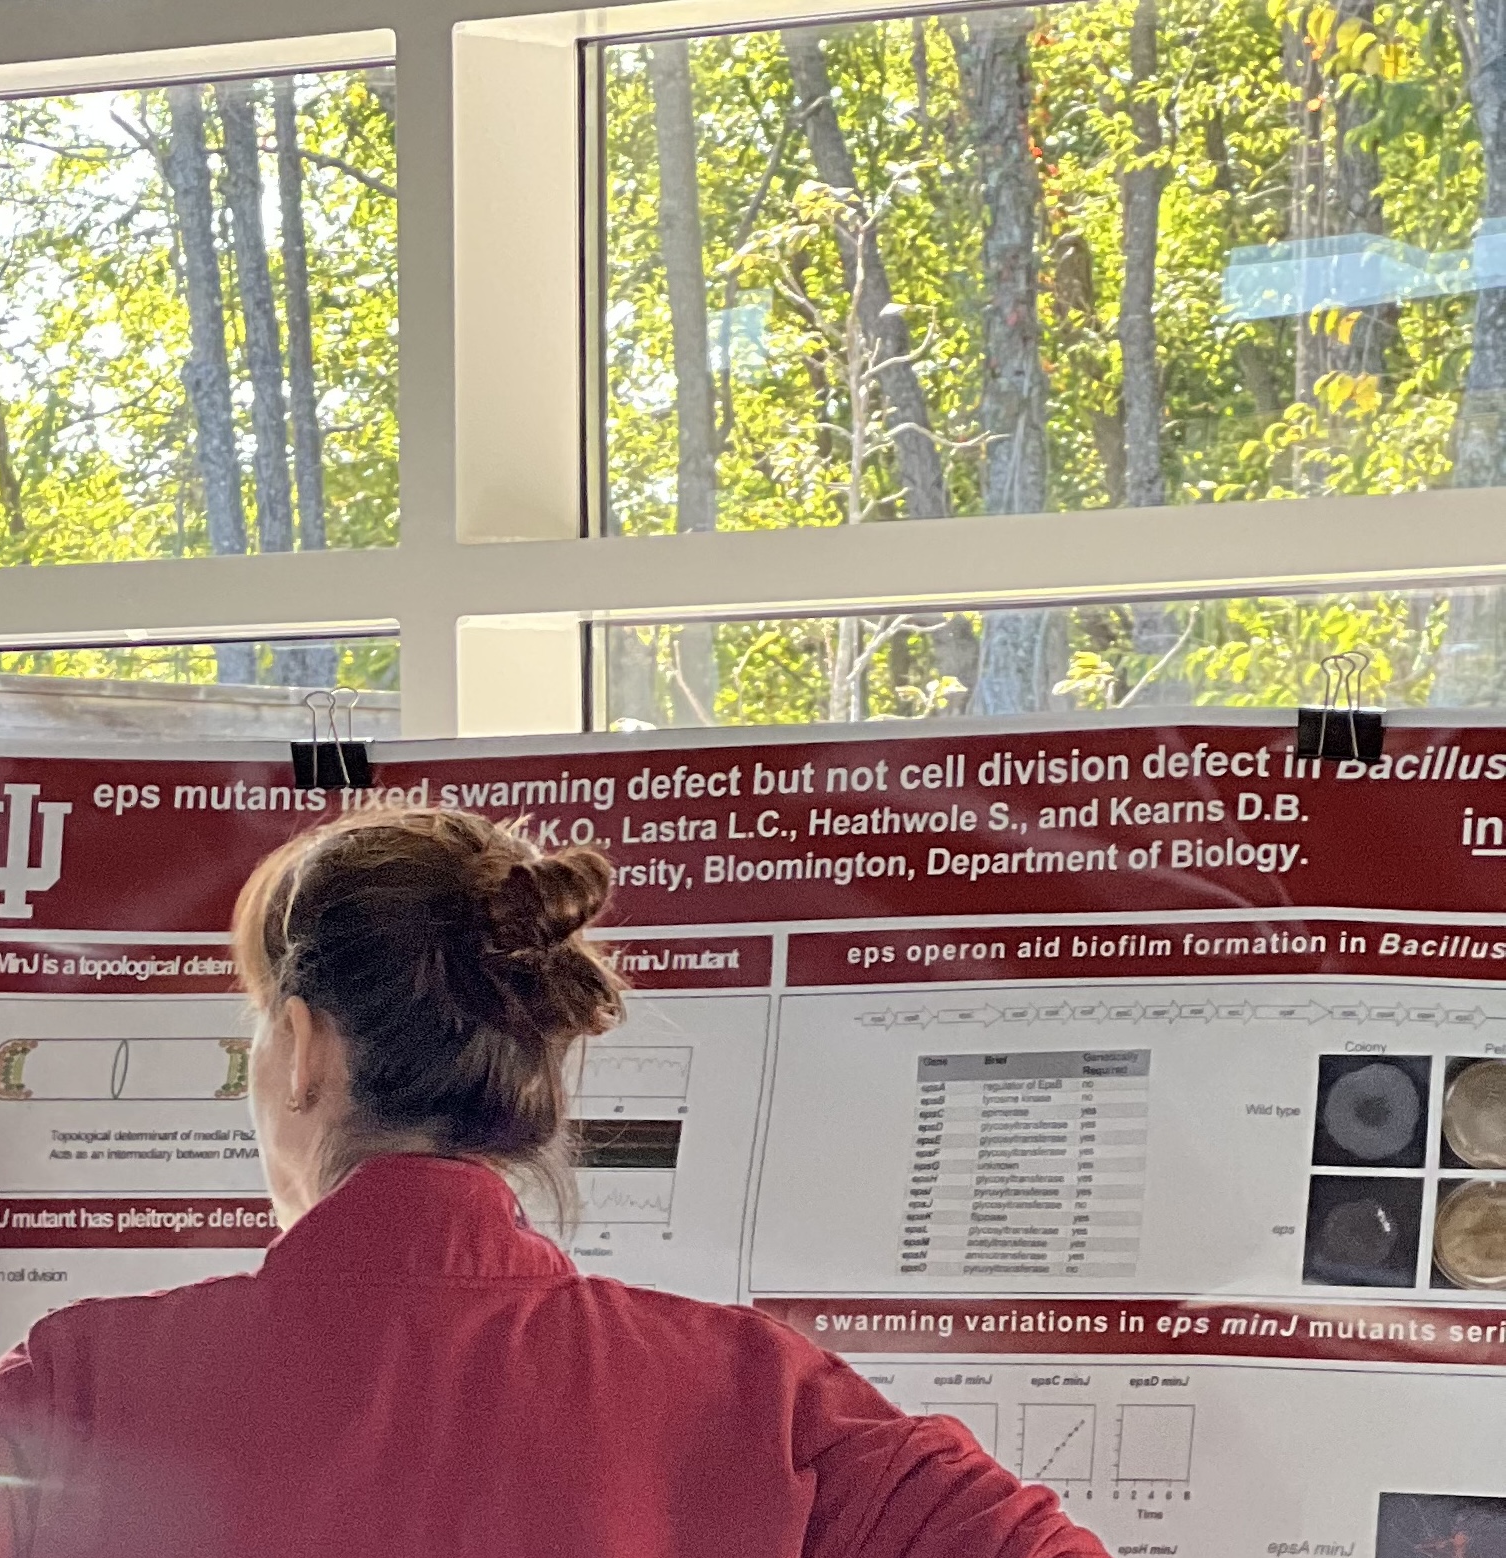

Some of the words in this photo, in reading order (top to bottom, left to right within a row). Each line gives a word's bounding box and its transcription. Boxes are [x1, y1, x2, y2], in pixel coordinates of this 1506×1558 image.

[93, 783, 160, 815] eps
[174, 778, 326, 811] mutants
[340, 777, 428, 811] fixed
[441, 770, 615, 810] swarming
[627, 764, 742, 801] defect
[753, 762, 815, 795] but
[826, 759, 887, 793] not
[900, 754, 965, 789] cell
[978, 747, 1129, 787] division
[1142, 744, 1271, 779] defect
[1285, 746, 1321, 779] in
[1336, 746, 1506, 780] Bacillus
[623, 811, 718, 845] Lastra
[728, 810, 798, 843] L.C.,
[809, 804, 977, 837] Heathwole
[988, 801, 1028, 836] S.,
[1038, 799, 1099, 830] and
[1110, 796, 1224, 827] Kearns
[1237, 793, 1309, 823] D.B.
[1462, 807, 1503, 845] in
[606, 860, 692, 891] ersity,
[704, 854, 915, 888] Bloomington,
[926, 843, 1118, 882] Department
[1128, 838, 1161, 869] of
[1171, 837, 1309, 873] Biology.
[623, 949, 671, 970] minJ
[672, 949, 740, 970] mutant
[847, 945, 895, 969] eps
[906, 941, 1006, 967] operon
[1017, 935, 1061, 960] aid
[1072, 934, 1172, 958] biofilm
[1182, 932, 1327, 957] formation
[1339, 931, 1367, 954] in
[1379, 932, 1506, 960] Bacillus
[42, 953, 59, 975] is
[62, 956, 76, 975] a
[78, 955, 181, 981] topological
[183, 956, 242, 977] determ
[1345, 1040, 1387, 1053] Colony
[1245, 1104, 1273, 1115] Wild
[1276, 1105, 1301, 1118] type
[51, 1130, 111, 1143] Topological
[114, 1130, 178, 1142] determinant
[180, 1130, 192, 1142] of
[193, 1130, 230, 1142] medial
[49, 1148, 73, 1160] Acts
[76, 1150, 88, 1160] as
[90, 1149, 105, 1160] an
[107, 1148, 173, 1161] intermediary
[176, 1148, 221, 1160] between
[12, 1209, 78, 1229] mutant
[81, 1208, 114, 1229] has
[117, 1207, 206, 1233] pleitropic
[7, 1269, 25, 1281] cell
[27, 1268, 67, 1281] division
[814, 1311, 955, 1338] swarming
[965, 1310, 1108, 1333] variations
[1119, 1310, 1146, 1332] in
[1156, 1314, 1211, 1341] eps
[1221, 1311, 1299, 1338] minJ
[1308, 1317, 1437, 1343] mutants
[1137, 1508, 1163, 1520] Time
[1267, 1540, 1310, 1557] epsA
[1313, 1542, 1355, 1557] minJ
